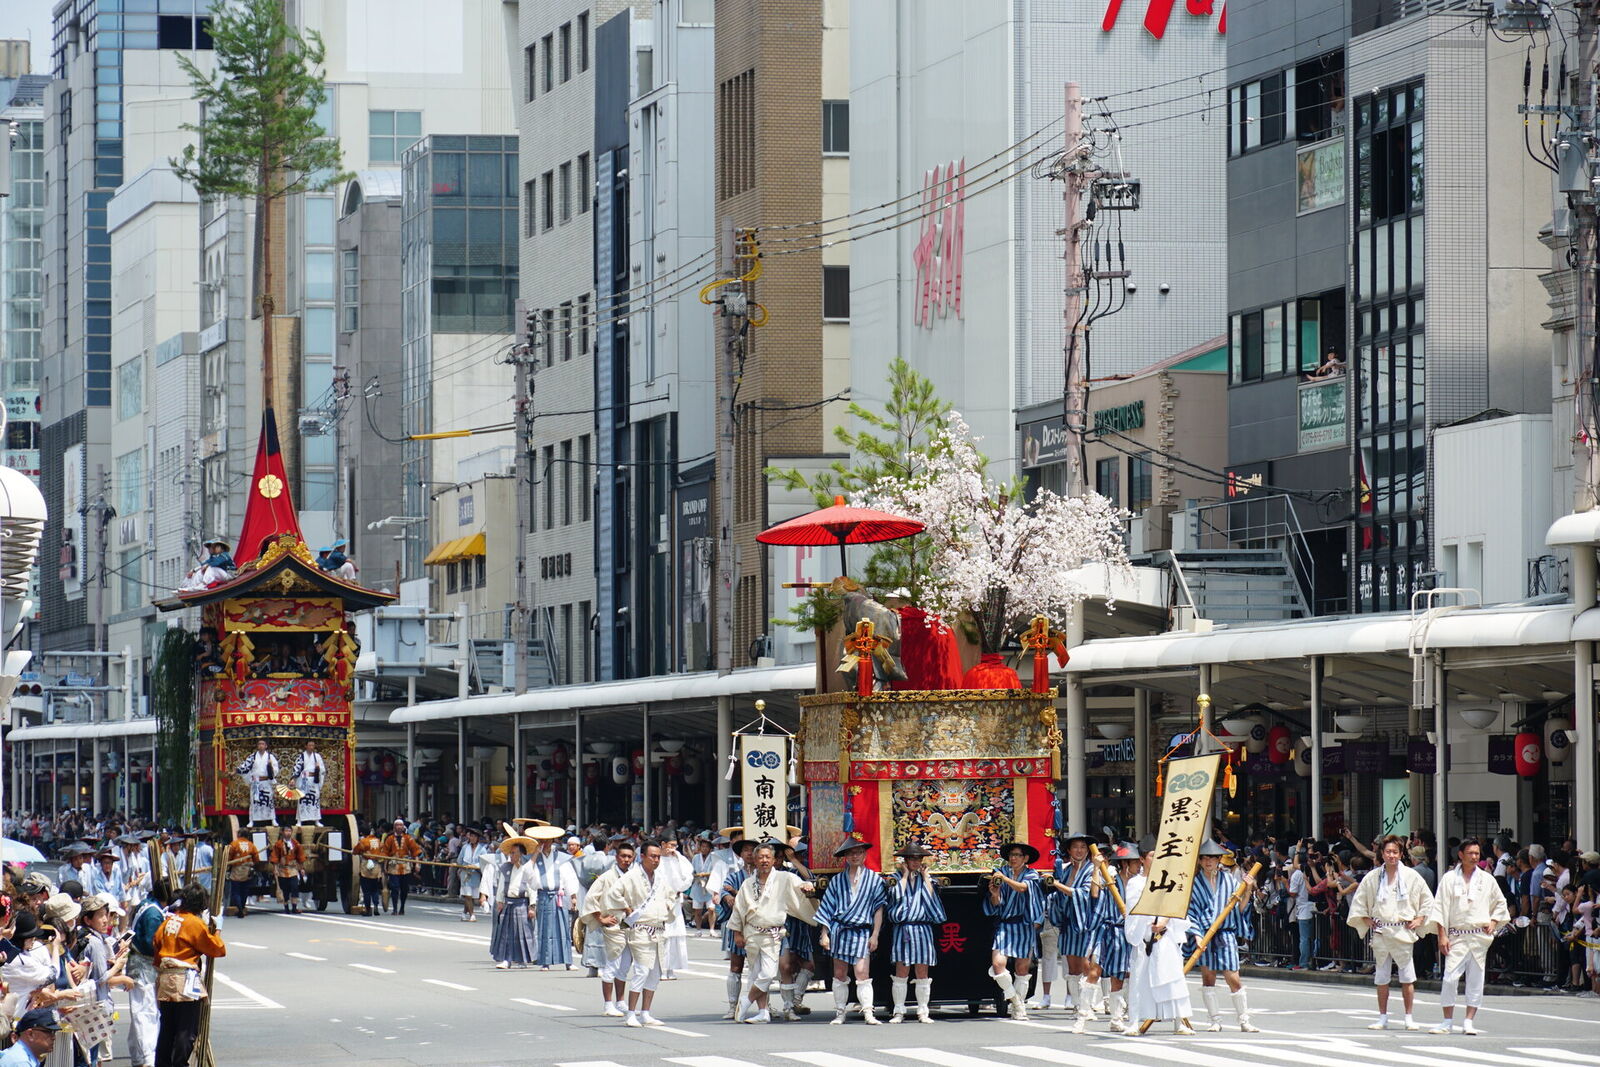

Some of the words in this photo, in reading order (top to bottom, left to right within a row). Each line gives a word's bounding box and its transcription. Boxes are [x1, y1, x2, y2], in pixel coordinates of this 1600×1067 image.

[1379, 585, 1389, 597] TEL
[1149, 796, 1193, 893] 黒主山
